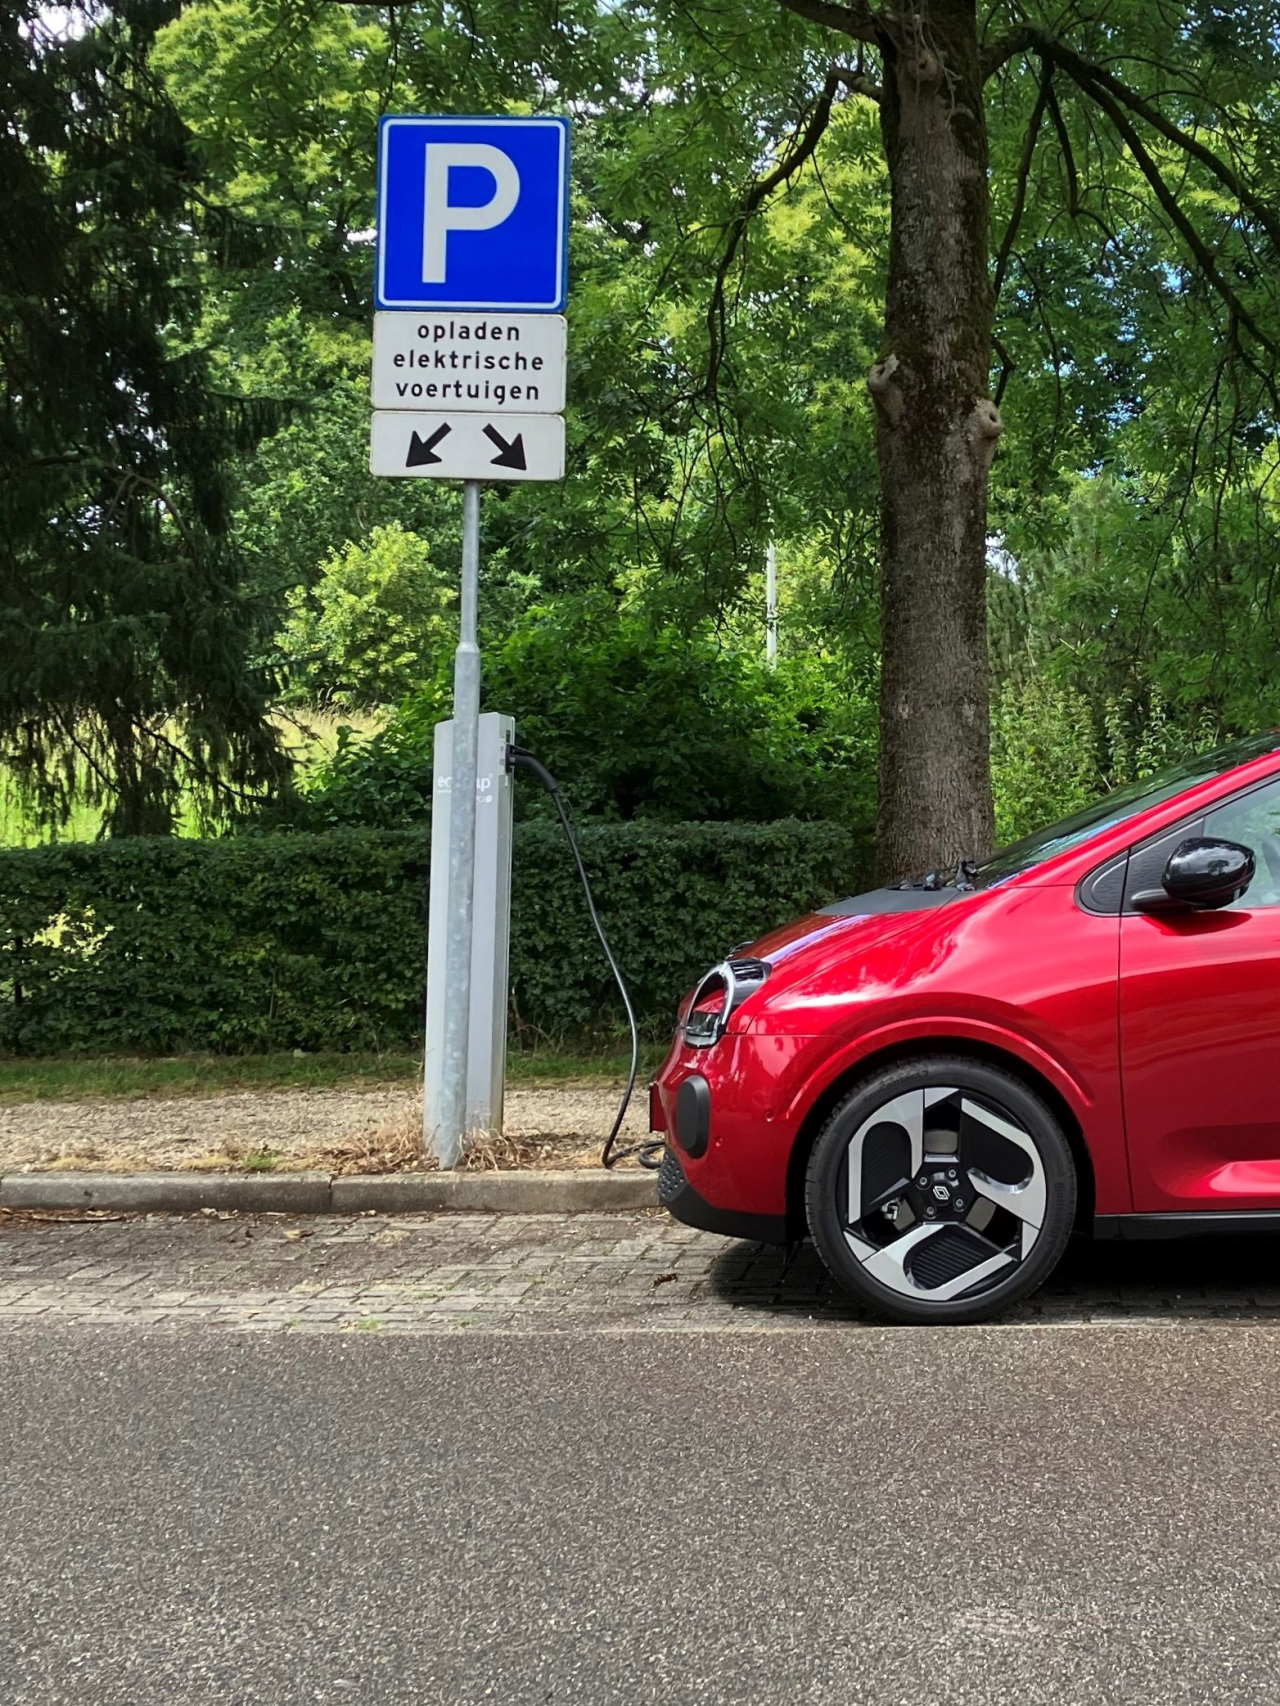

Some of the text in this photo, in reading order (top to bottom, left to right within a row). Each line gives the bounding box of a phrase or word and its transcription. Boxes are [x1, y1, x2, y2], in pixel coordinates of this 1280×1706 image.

[422, 143, 520, 284] P
[418, 321, 520, 343] opladen
[393, 350, 544, 371] elektrische
[396, 380, 539, 405] voertuigen
